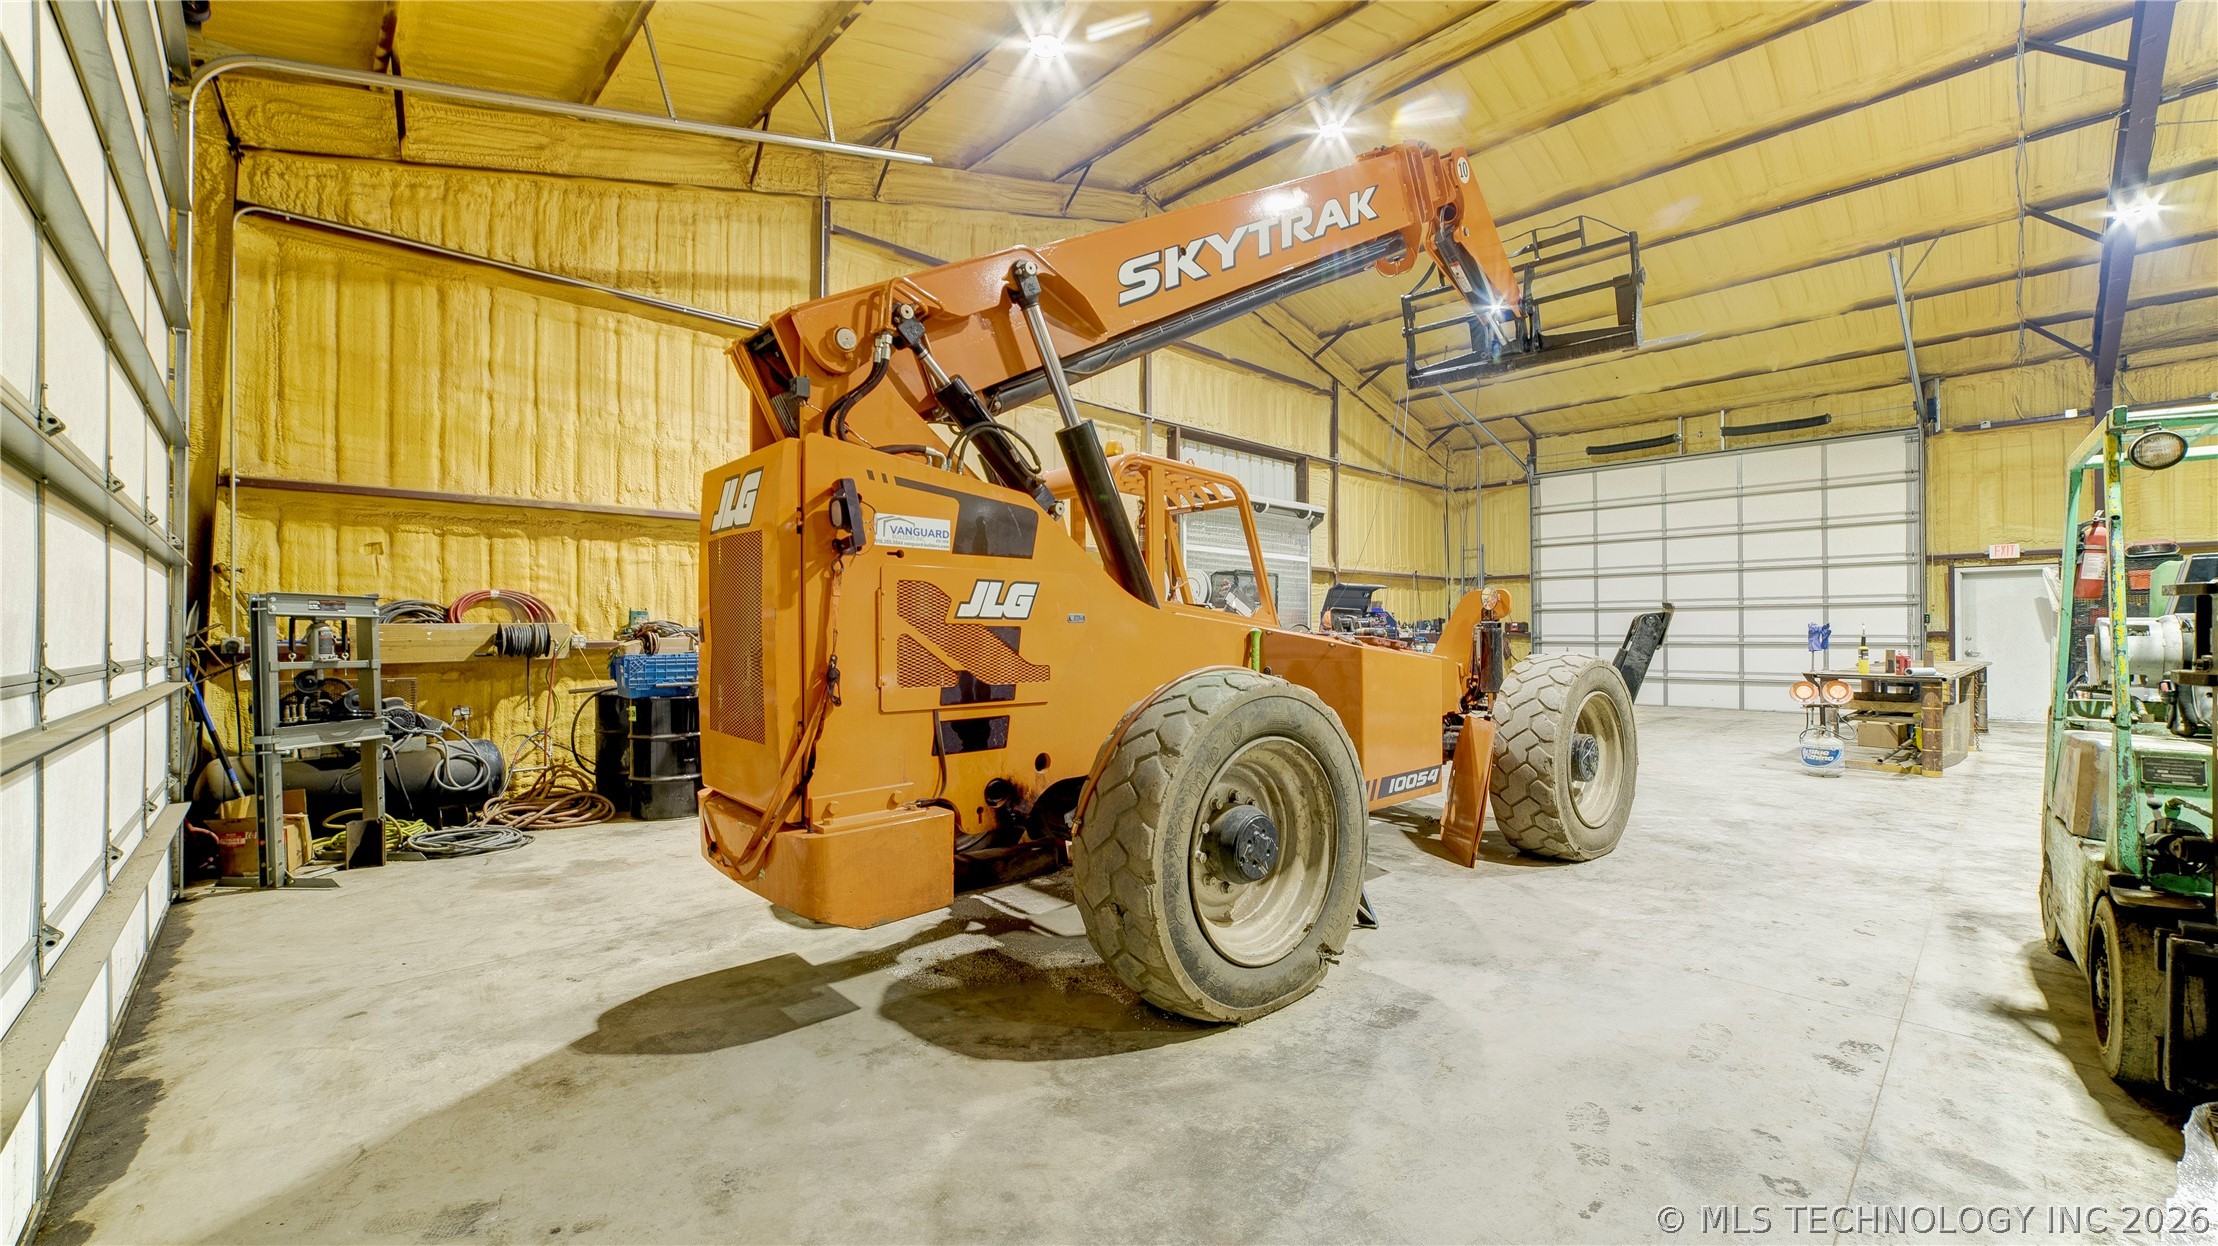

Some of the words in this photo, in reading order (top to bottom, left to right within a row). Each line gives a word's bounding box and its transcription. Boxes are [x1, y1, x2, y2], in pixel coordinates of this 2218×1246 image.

[1458, 161, 1469, 178] 10
[1118, 185, 1379, 306] SKYTRAK
[710, 466, 764, 534] JLG
[890, 525, 950, 539] VANGUARD
[1994, 544, 2016, 557] EXIT
[955, 579, 1040, 620] JLG
[1388, 768, 1440, 794] 10054
